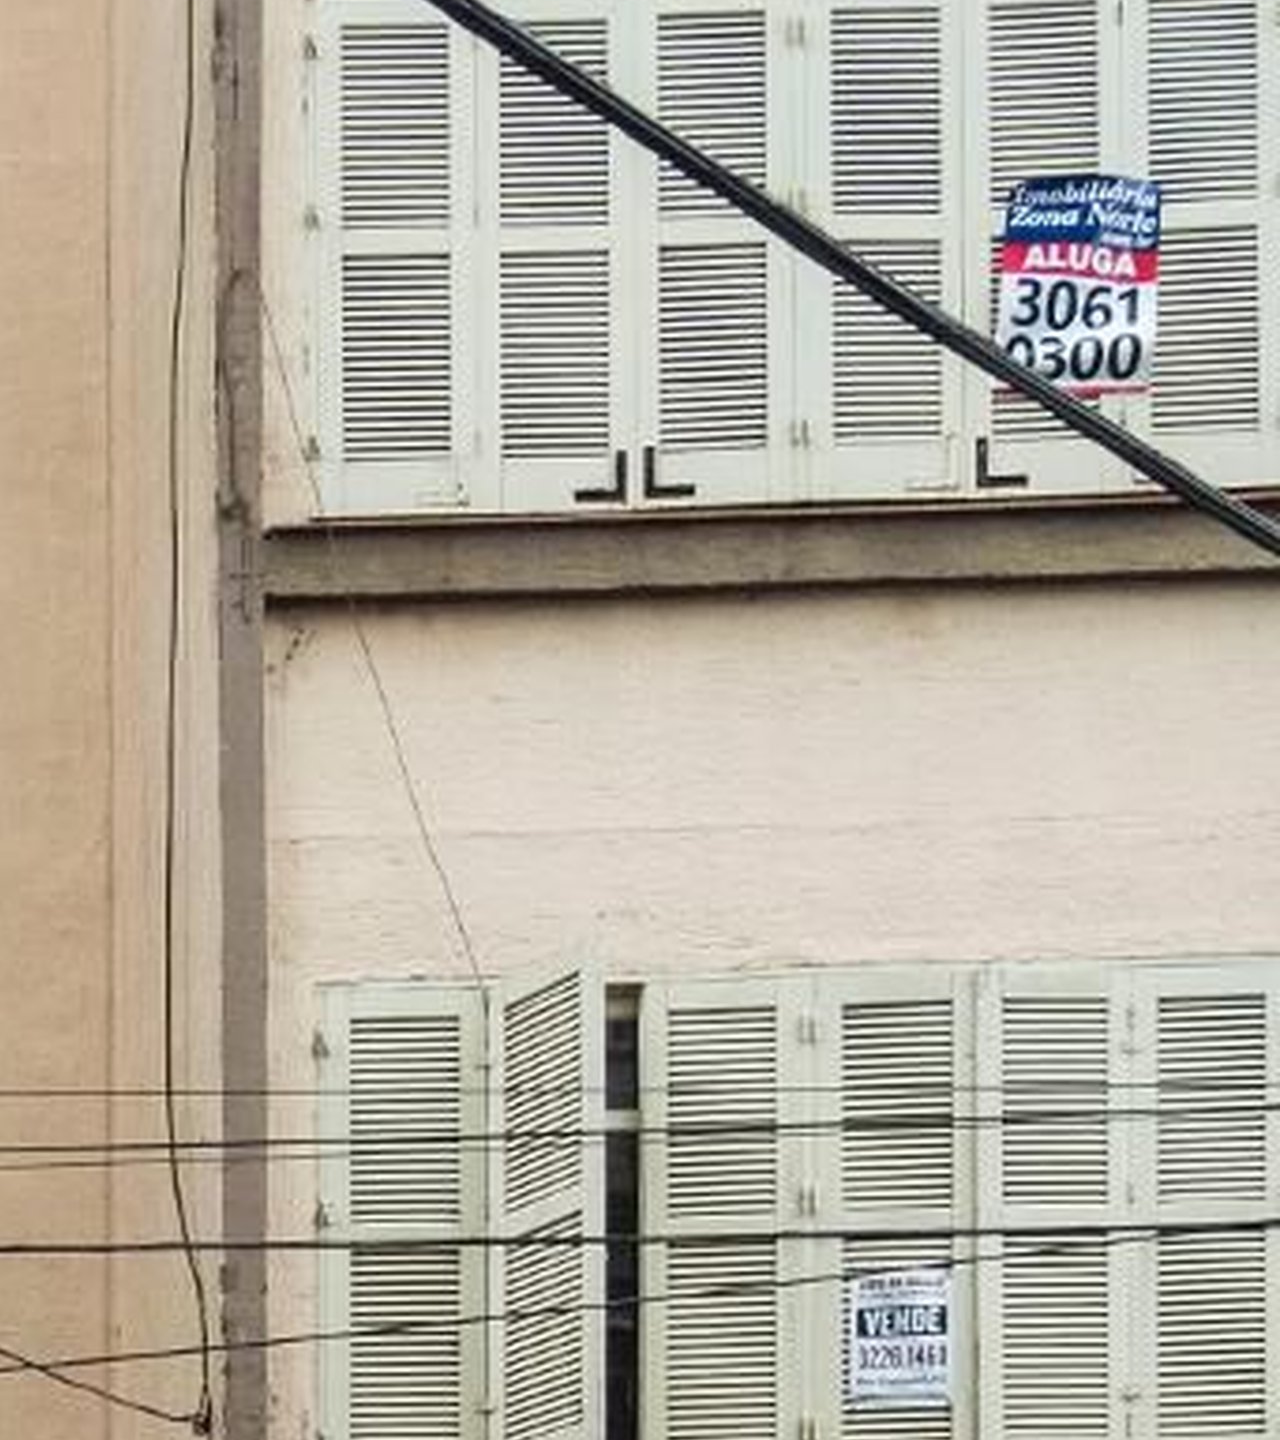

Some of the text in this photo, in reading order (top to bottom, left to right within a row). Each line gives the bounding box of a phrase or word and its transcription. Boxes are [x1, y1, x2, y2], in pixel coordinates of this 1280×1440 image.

[1009, 203, 1157, 234] Zona Norte
[1021, 242, 1137, 278] ALUGA
[1010, 278, 1140, 331] 3061
[863, 1306, 942, 1337] VENDE
